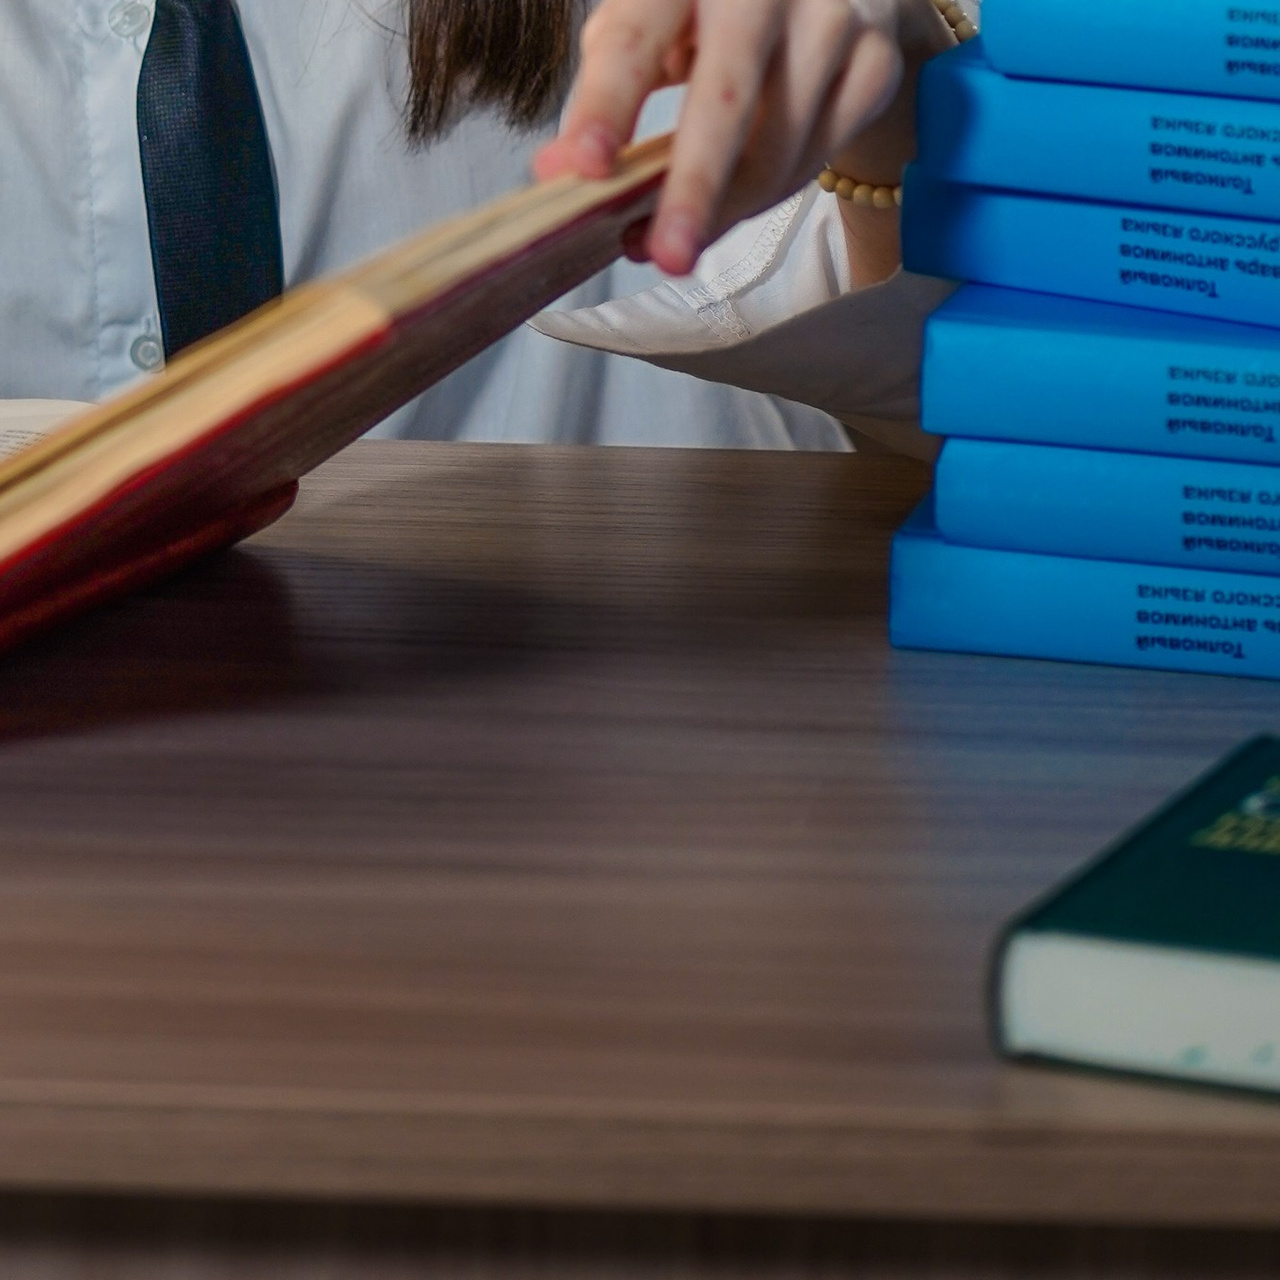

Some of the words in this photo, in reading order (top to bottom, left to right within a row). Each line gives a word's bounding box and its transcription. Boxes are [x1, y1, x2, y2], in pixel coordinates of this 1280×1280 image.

[1151, 115, 1217, 137] языка
[1150, 143, 1266, 168] антонимов
[1150, 167, 1255, 195] Толковый
[1121, 217, 1184, 239] языка
[1120, 243, 1230, 271] антонимов
[1120, 268, 1220, 298] Толковый
[1168, 365, 1238, 385] языка
[1167, 391, 1280, 415] нтонимов
[1167, 417, 1276, 443] Толковый
[1183, 484, 1252, 505] языка
[1182, 510, 1280, 533] тонимов
[1136, 584, 1206, 604] языка
[1136, 610, 1258, 633] антонимов
[1136, 634, 1247, 660] Толковый
